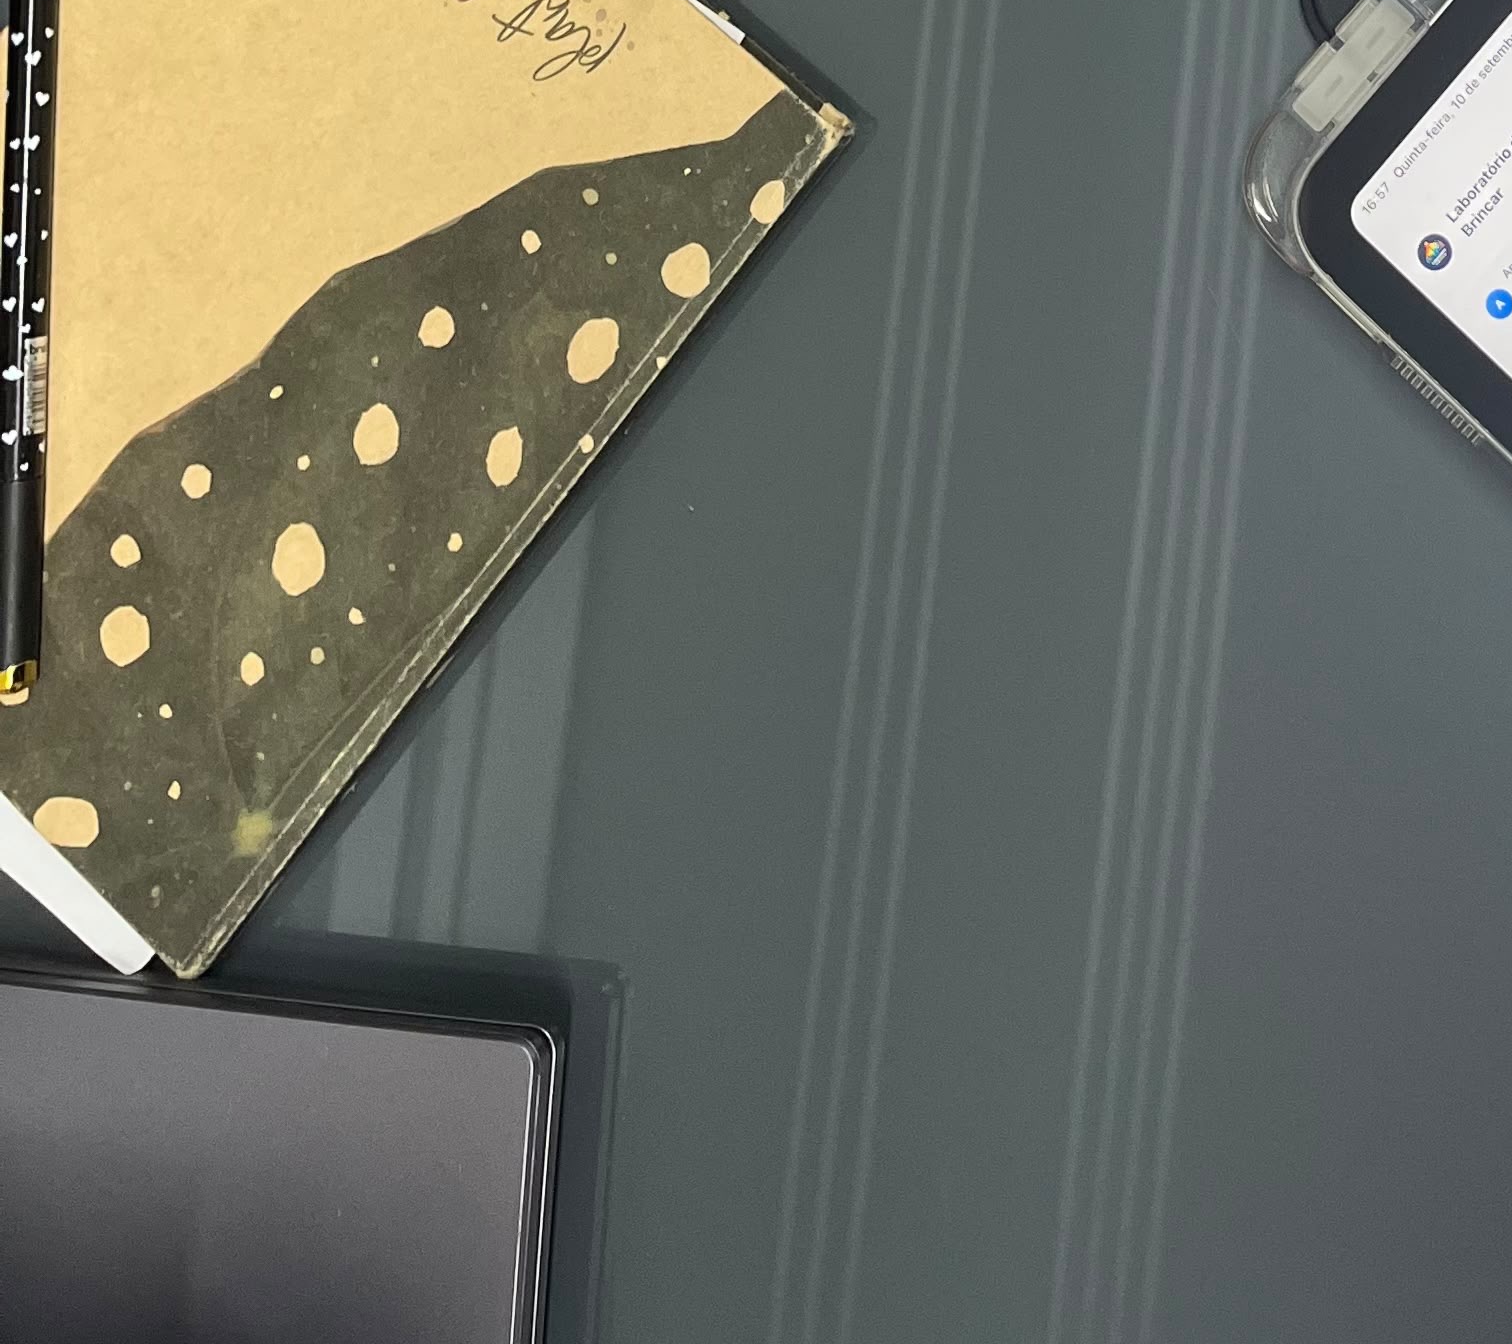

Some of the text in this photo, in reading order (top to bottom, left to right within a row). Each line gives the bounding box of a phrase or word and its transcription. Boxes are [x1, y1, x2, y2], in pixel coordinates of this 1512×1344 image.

[1450, 93, 1467, 110] 10
[1464, 78, 1480, 96] de
[1445, 148, 1512, 224] Laboratório
[1460, 187, 1504, 238] Brincar
